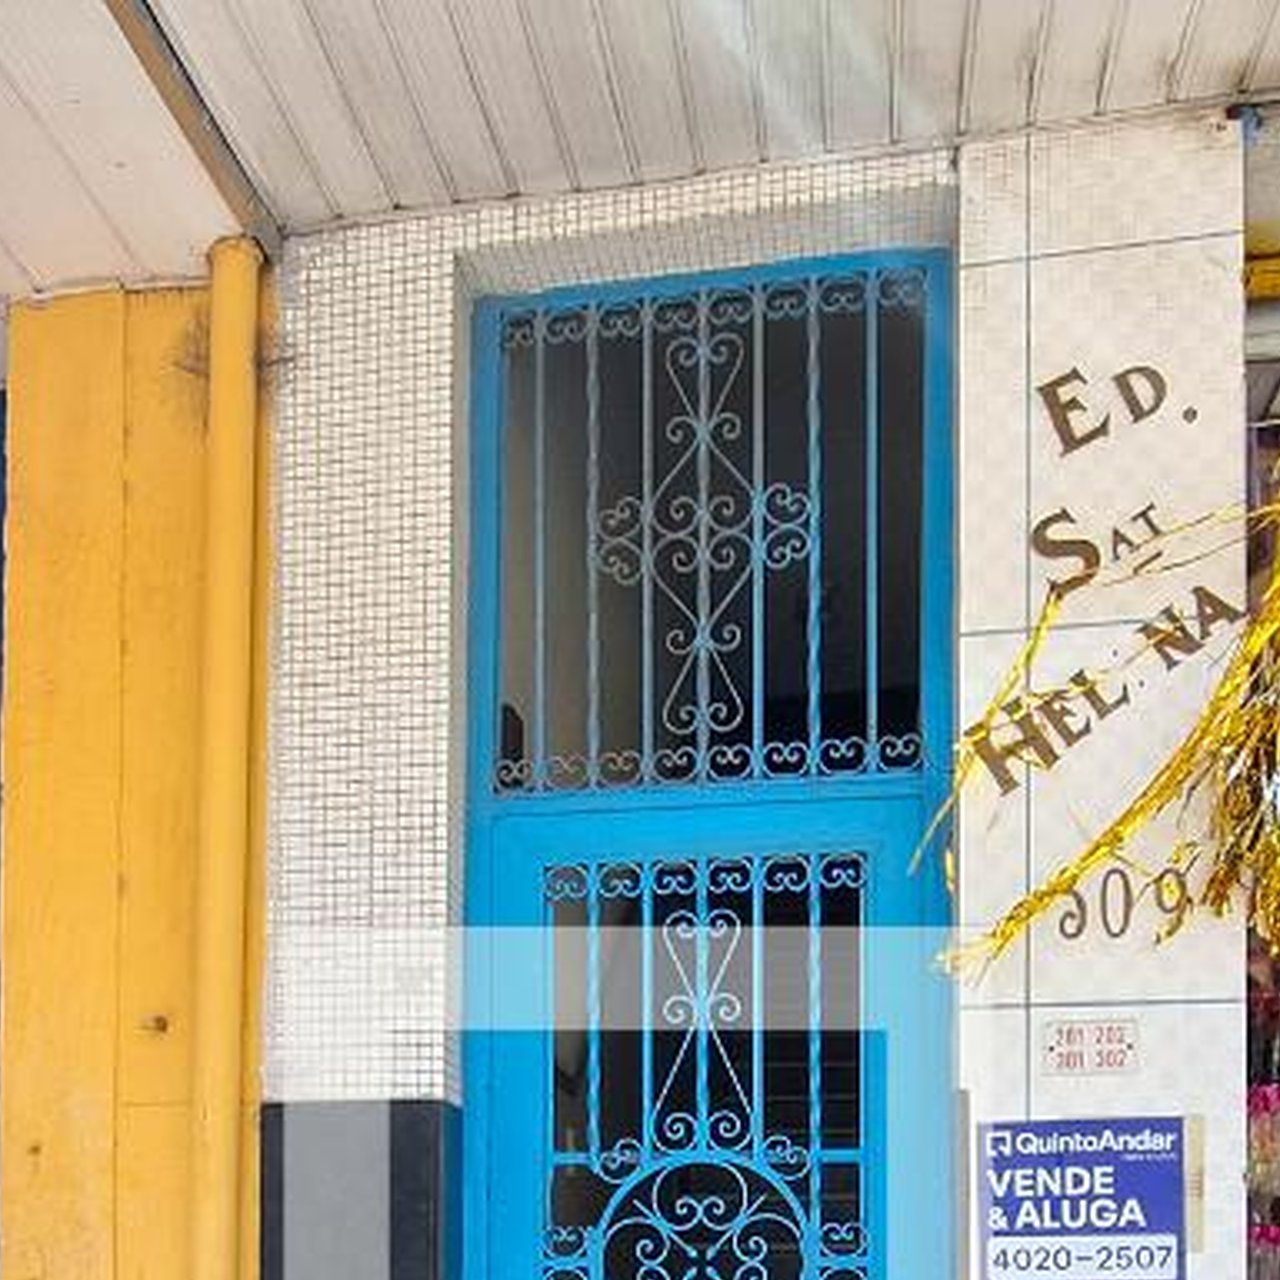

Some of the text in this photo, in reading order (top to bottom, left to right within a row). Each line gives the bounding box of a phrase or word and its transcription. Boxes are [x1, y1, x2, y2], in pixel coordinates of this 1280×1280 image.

[1034, 364, 1199, 459] ED.
[1015, 1129, 1177, 1154] QuintoAndar
[986, 1166, 1115, 1198] VENDE
[987, 1199, 1148, 1230] & ALUGA
[992, 1245, 1173, 1272] 4020-2507
